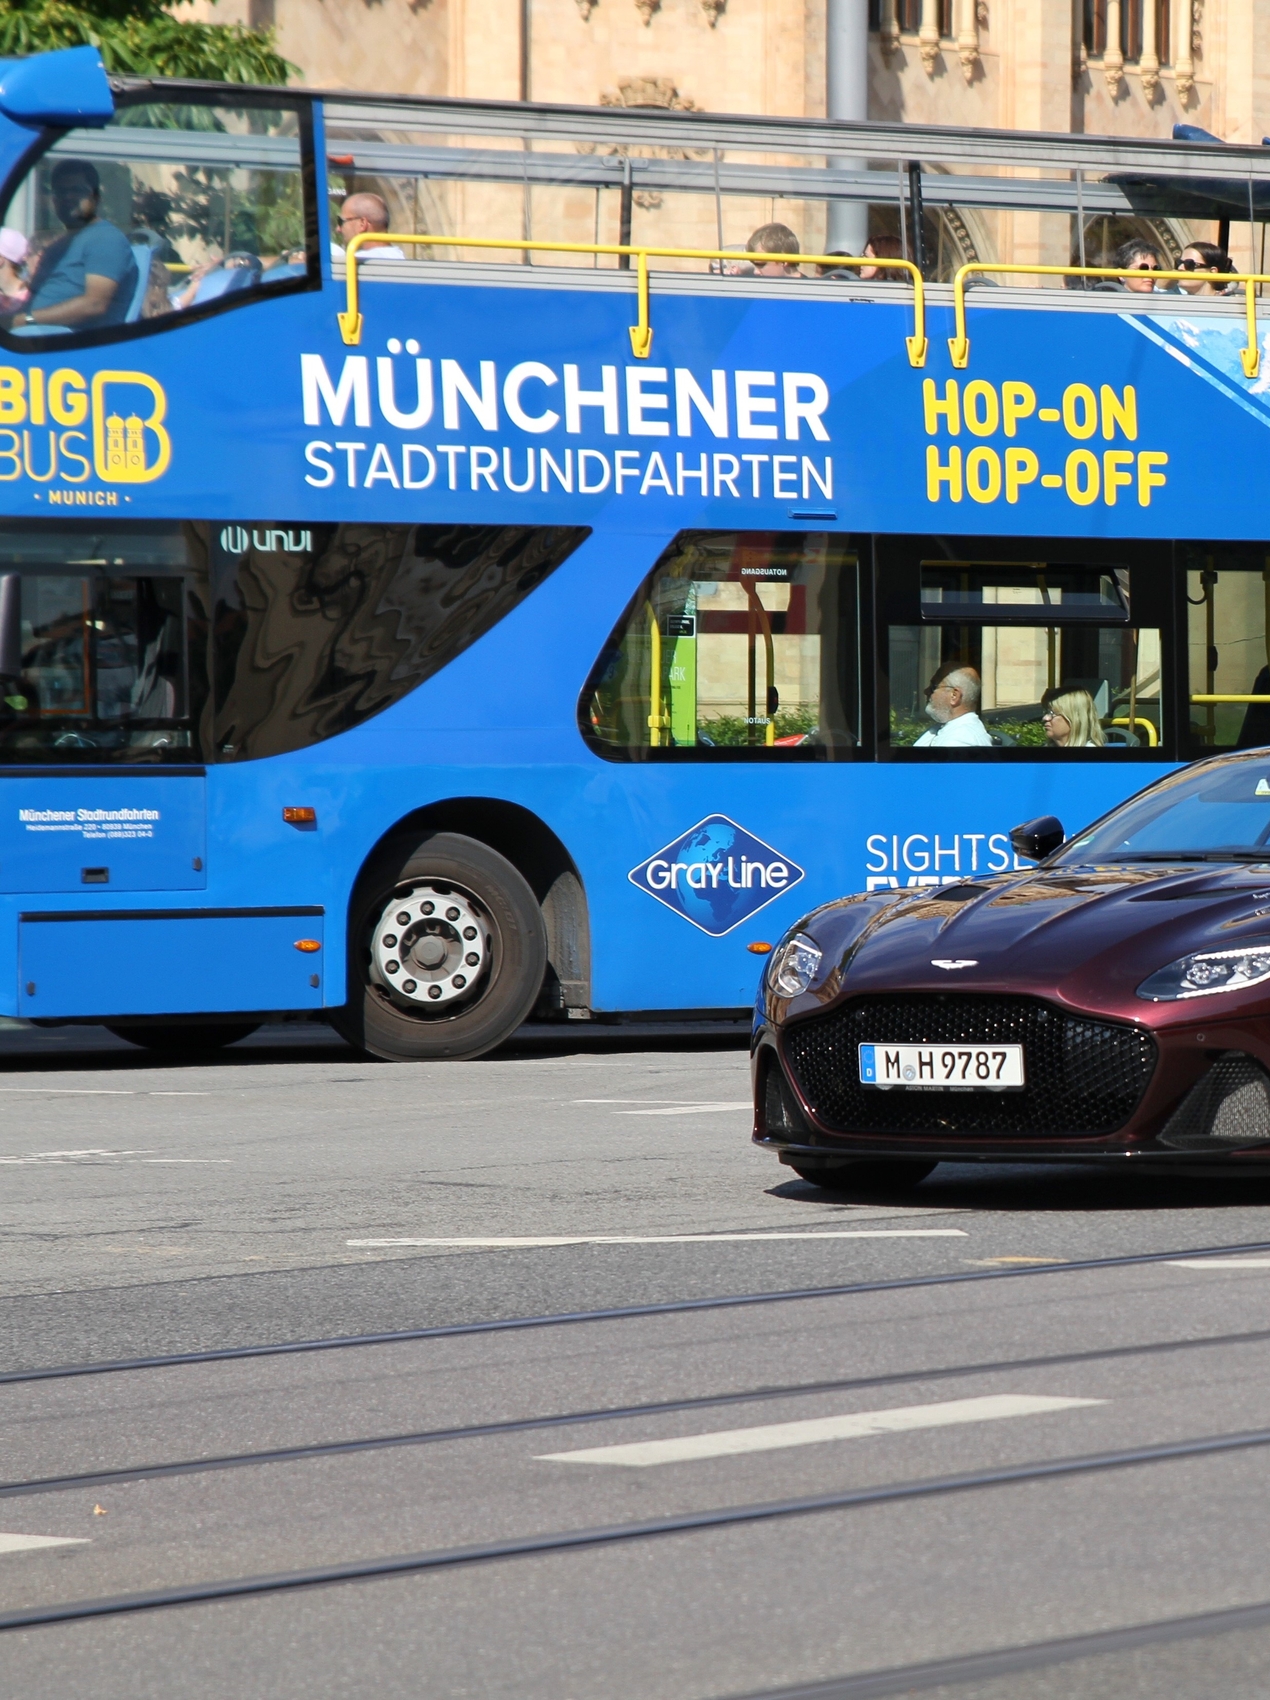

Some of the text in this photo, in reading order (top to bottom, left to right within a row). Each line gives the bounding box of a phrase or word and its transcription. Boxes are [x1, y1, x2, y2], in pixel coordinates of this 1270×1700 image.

[0, 365, 88, 426] BIG
[300, 338, 831, 441] MÜNCHENER
[922, 378, 1138, 441] HOP-ON
[0, 428, 91, 482] BUS
[303, 440, 833, 500] STADTRUNDFAHRTEN
[926, 444, 1169, 507] HOP-OFF
[48, 490, 118, 505] MUNICH
[19, 808, 159, 821] Münchener Stadtrundfahrten
[866, 1068, 873, 1077] D
